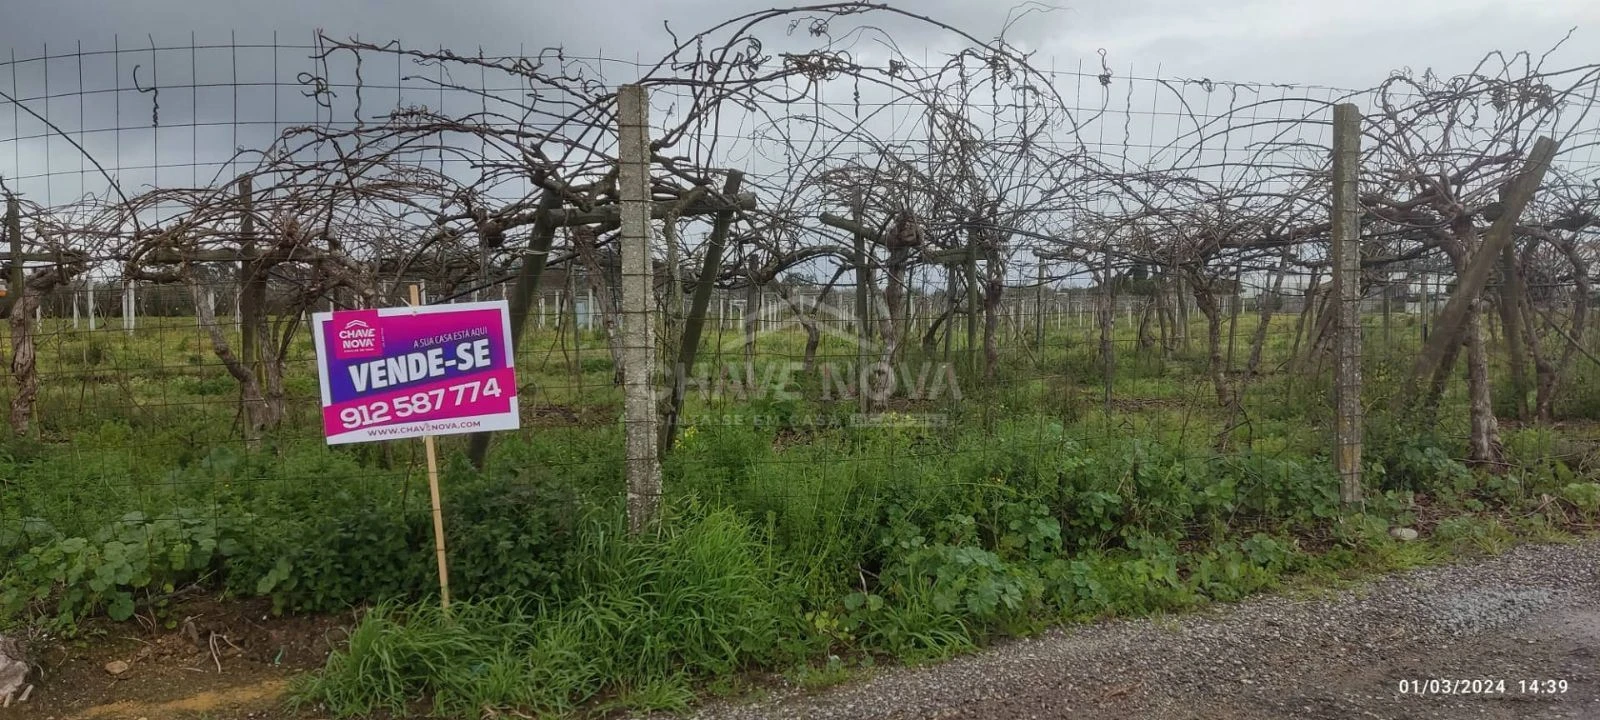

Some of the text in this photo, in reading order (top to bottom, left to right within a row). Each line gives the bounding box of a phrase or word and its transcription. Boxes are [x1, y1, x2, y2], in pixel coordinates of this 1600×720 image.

[338, 328, 376, 339] CHAVE
[342, 338, 374, 349] NOVA
[414, 326, 488, 349] A SUA CASA ESTÁ AQUI
[348, 338, 491, 393] VENDE-SE
[340, 377, 502, 429] 912 587 774
